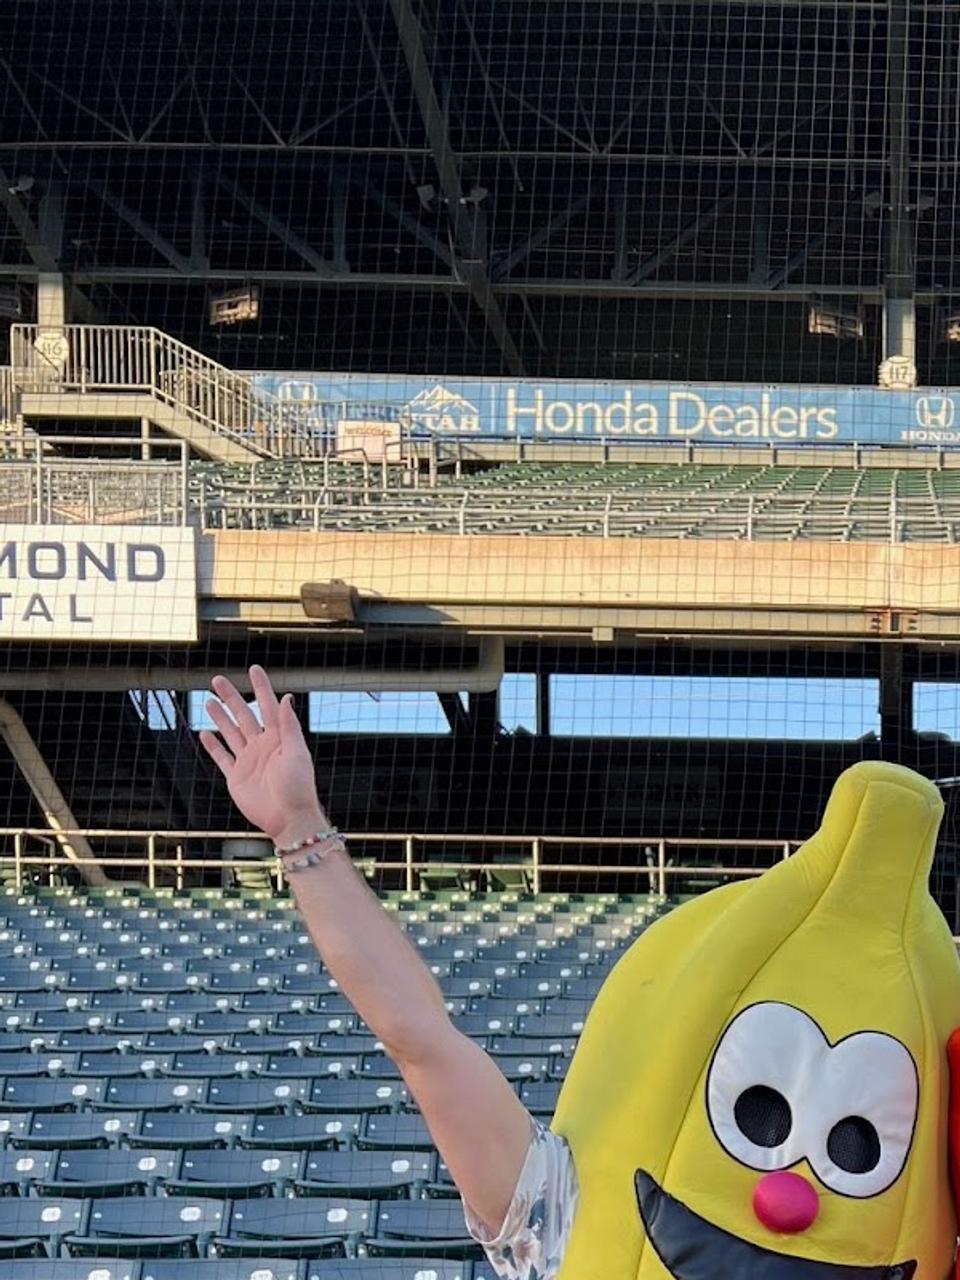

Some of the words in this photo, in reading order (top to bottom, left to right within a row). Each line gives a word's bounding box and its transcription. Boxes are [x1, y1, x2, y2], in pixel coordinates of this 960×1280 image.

[889, 364, 909, 380] 117
[506, 388, 659, 434] Honda
[669, 391, 839, 439] Dealers
